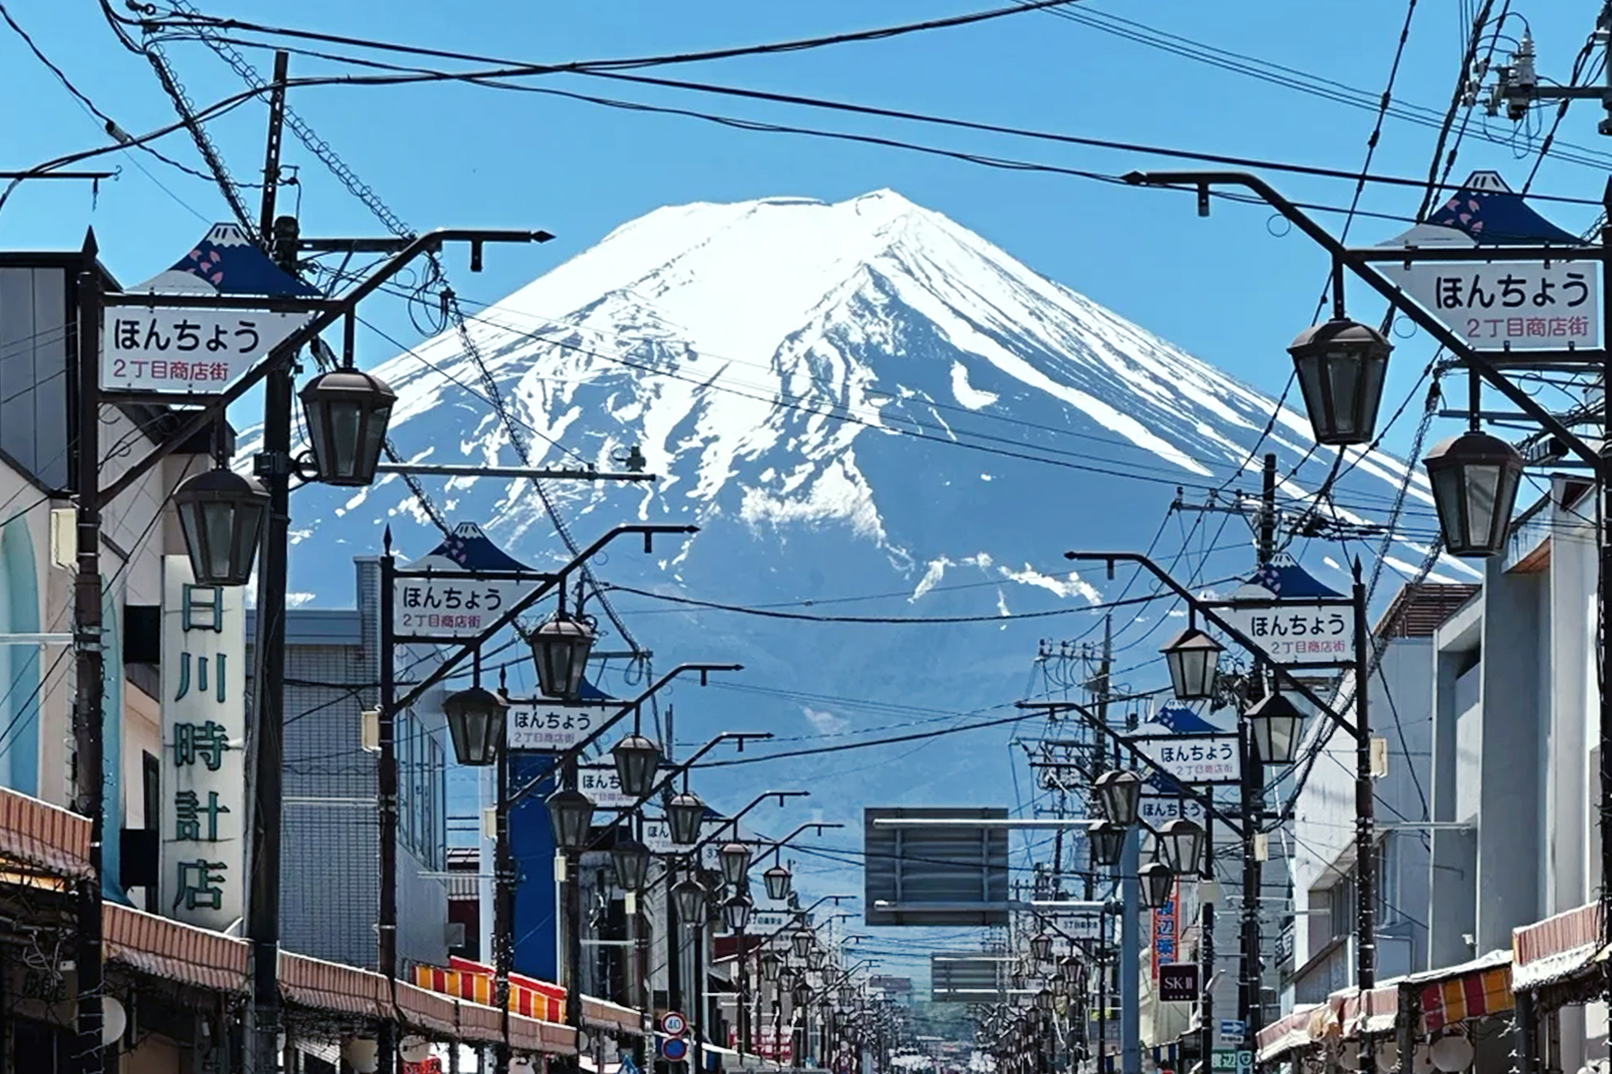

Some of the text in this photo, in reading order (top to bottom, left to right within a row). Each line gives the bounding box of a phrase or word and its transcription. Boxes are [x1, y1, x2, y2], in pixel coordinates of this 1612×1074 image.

[1436, 273, 1589, 309] ほんちょう
[114, 318, 260, 353] ほんちょう
[1466, 316, 1590, 339] 2丁目商店街
[113, 358, 230, 382] 2丁目商店街
[403, 586, 502, 611] ほんちょう
[402, 613, 481, 629] 2丁目商店街
[1251, 613, 1345, 637] ほんちょう
[1271, 640, 1346, 654] 2丁目商店街
[514, 711, 591, 731] ほんちょう
[173, 583, 232, 916] 日川時計店
[1160, 743, 1233, 763] ほんちょう
[582, 774, 621, 790] ほんち
[668, 1019, 680, 1029] 40
